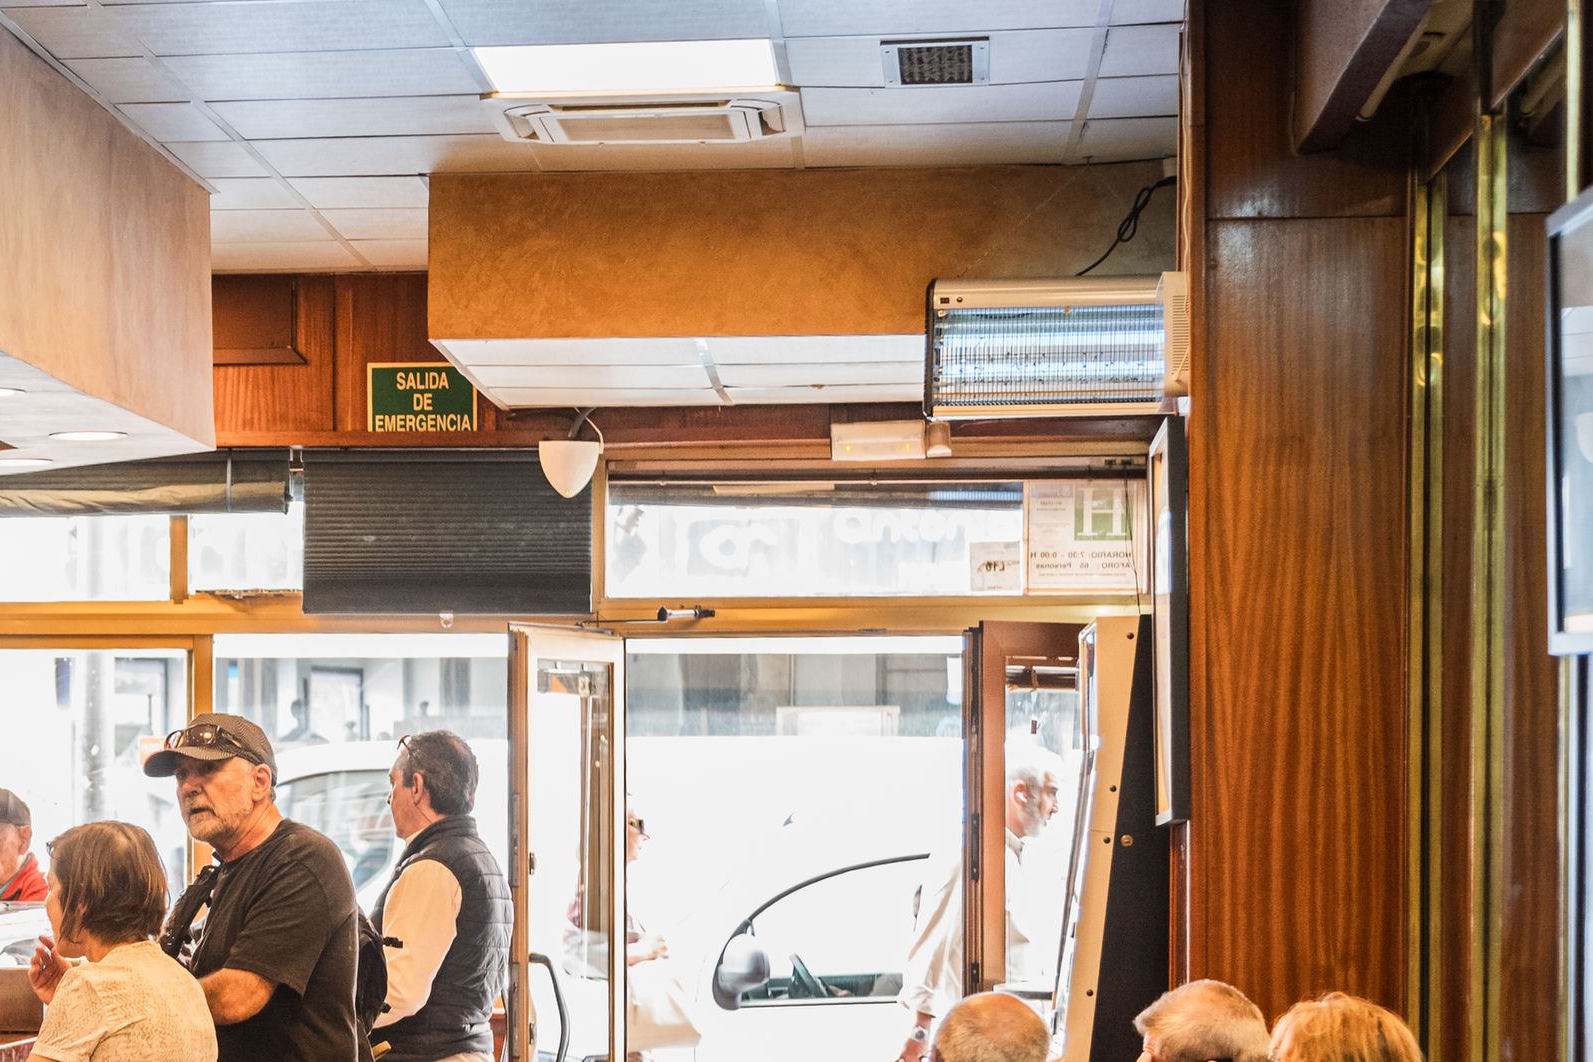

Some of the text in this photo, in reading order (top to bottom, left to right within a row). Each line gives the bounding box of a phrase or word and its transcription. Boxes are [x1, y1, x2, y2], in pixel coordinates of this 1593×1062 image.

[396, 371, 449, 390] SALIDA
[413, 393, 433, 411] DE
[375, 413, 471, 432] EMERGENCIA
